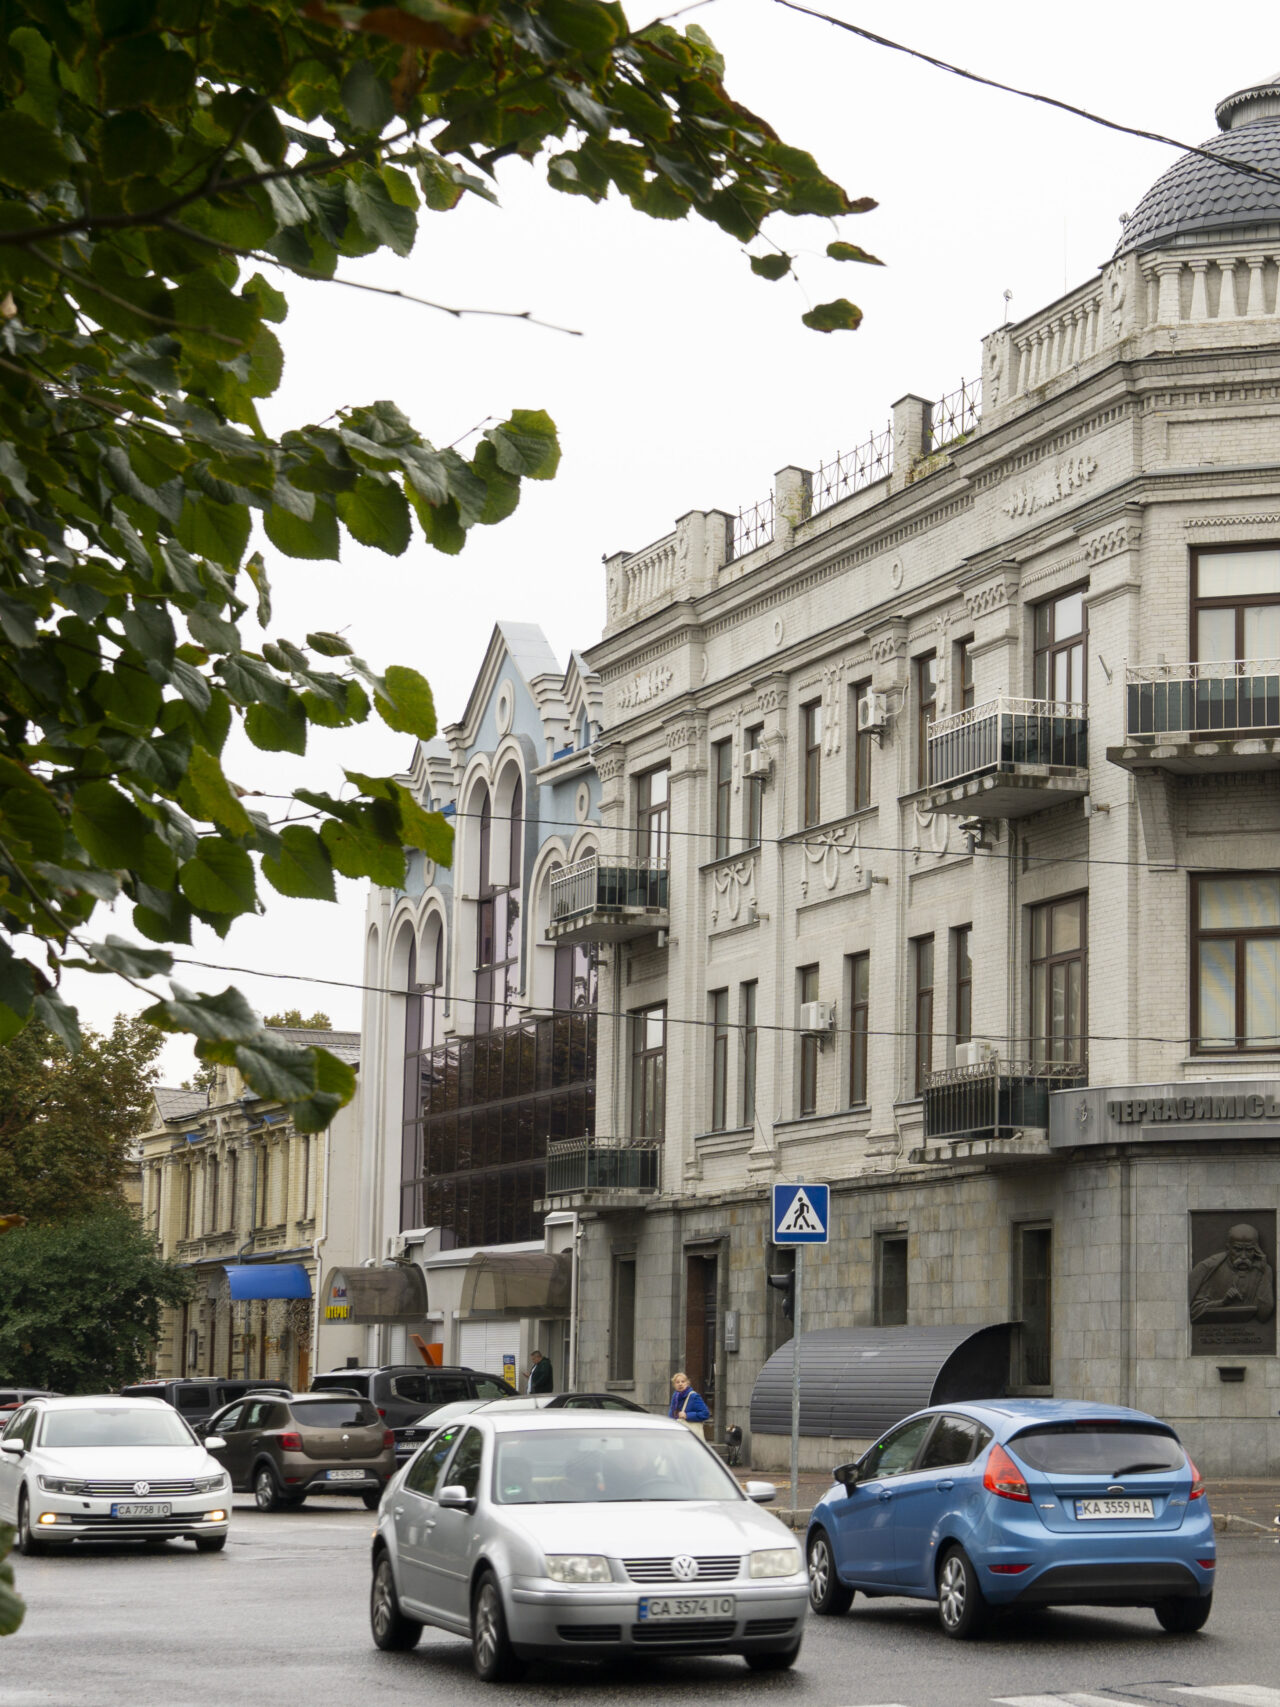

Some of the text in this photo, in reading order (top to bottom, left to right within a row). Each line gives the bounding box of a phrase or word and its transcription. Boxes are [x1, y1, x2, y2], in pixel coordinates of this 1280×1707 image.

[119, 1505, 131, 1515] CA
[134, 1505, 154, 1514] 7758
[1082, 1501, 1150, 1515] KA 3559 HA
[649, 1601, 671, 1616] CA
[674, 1600, 708, 1615] 3574
